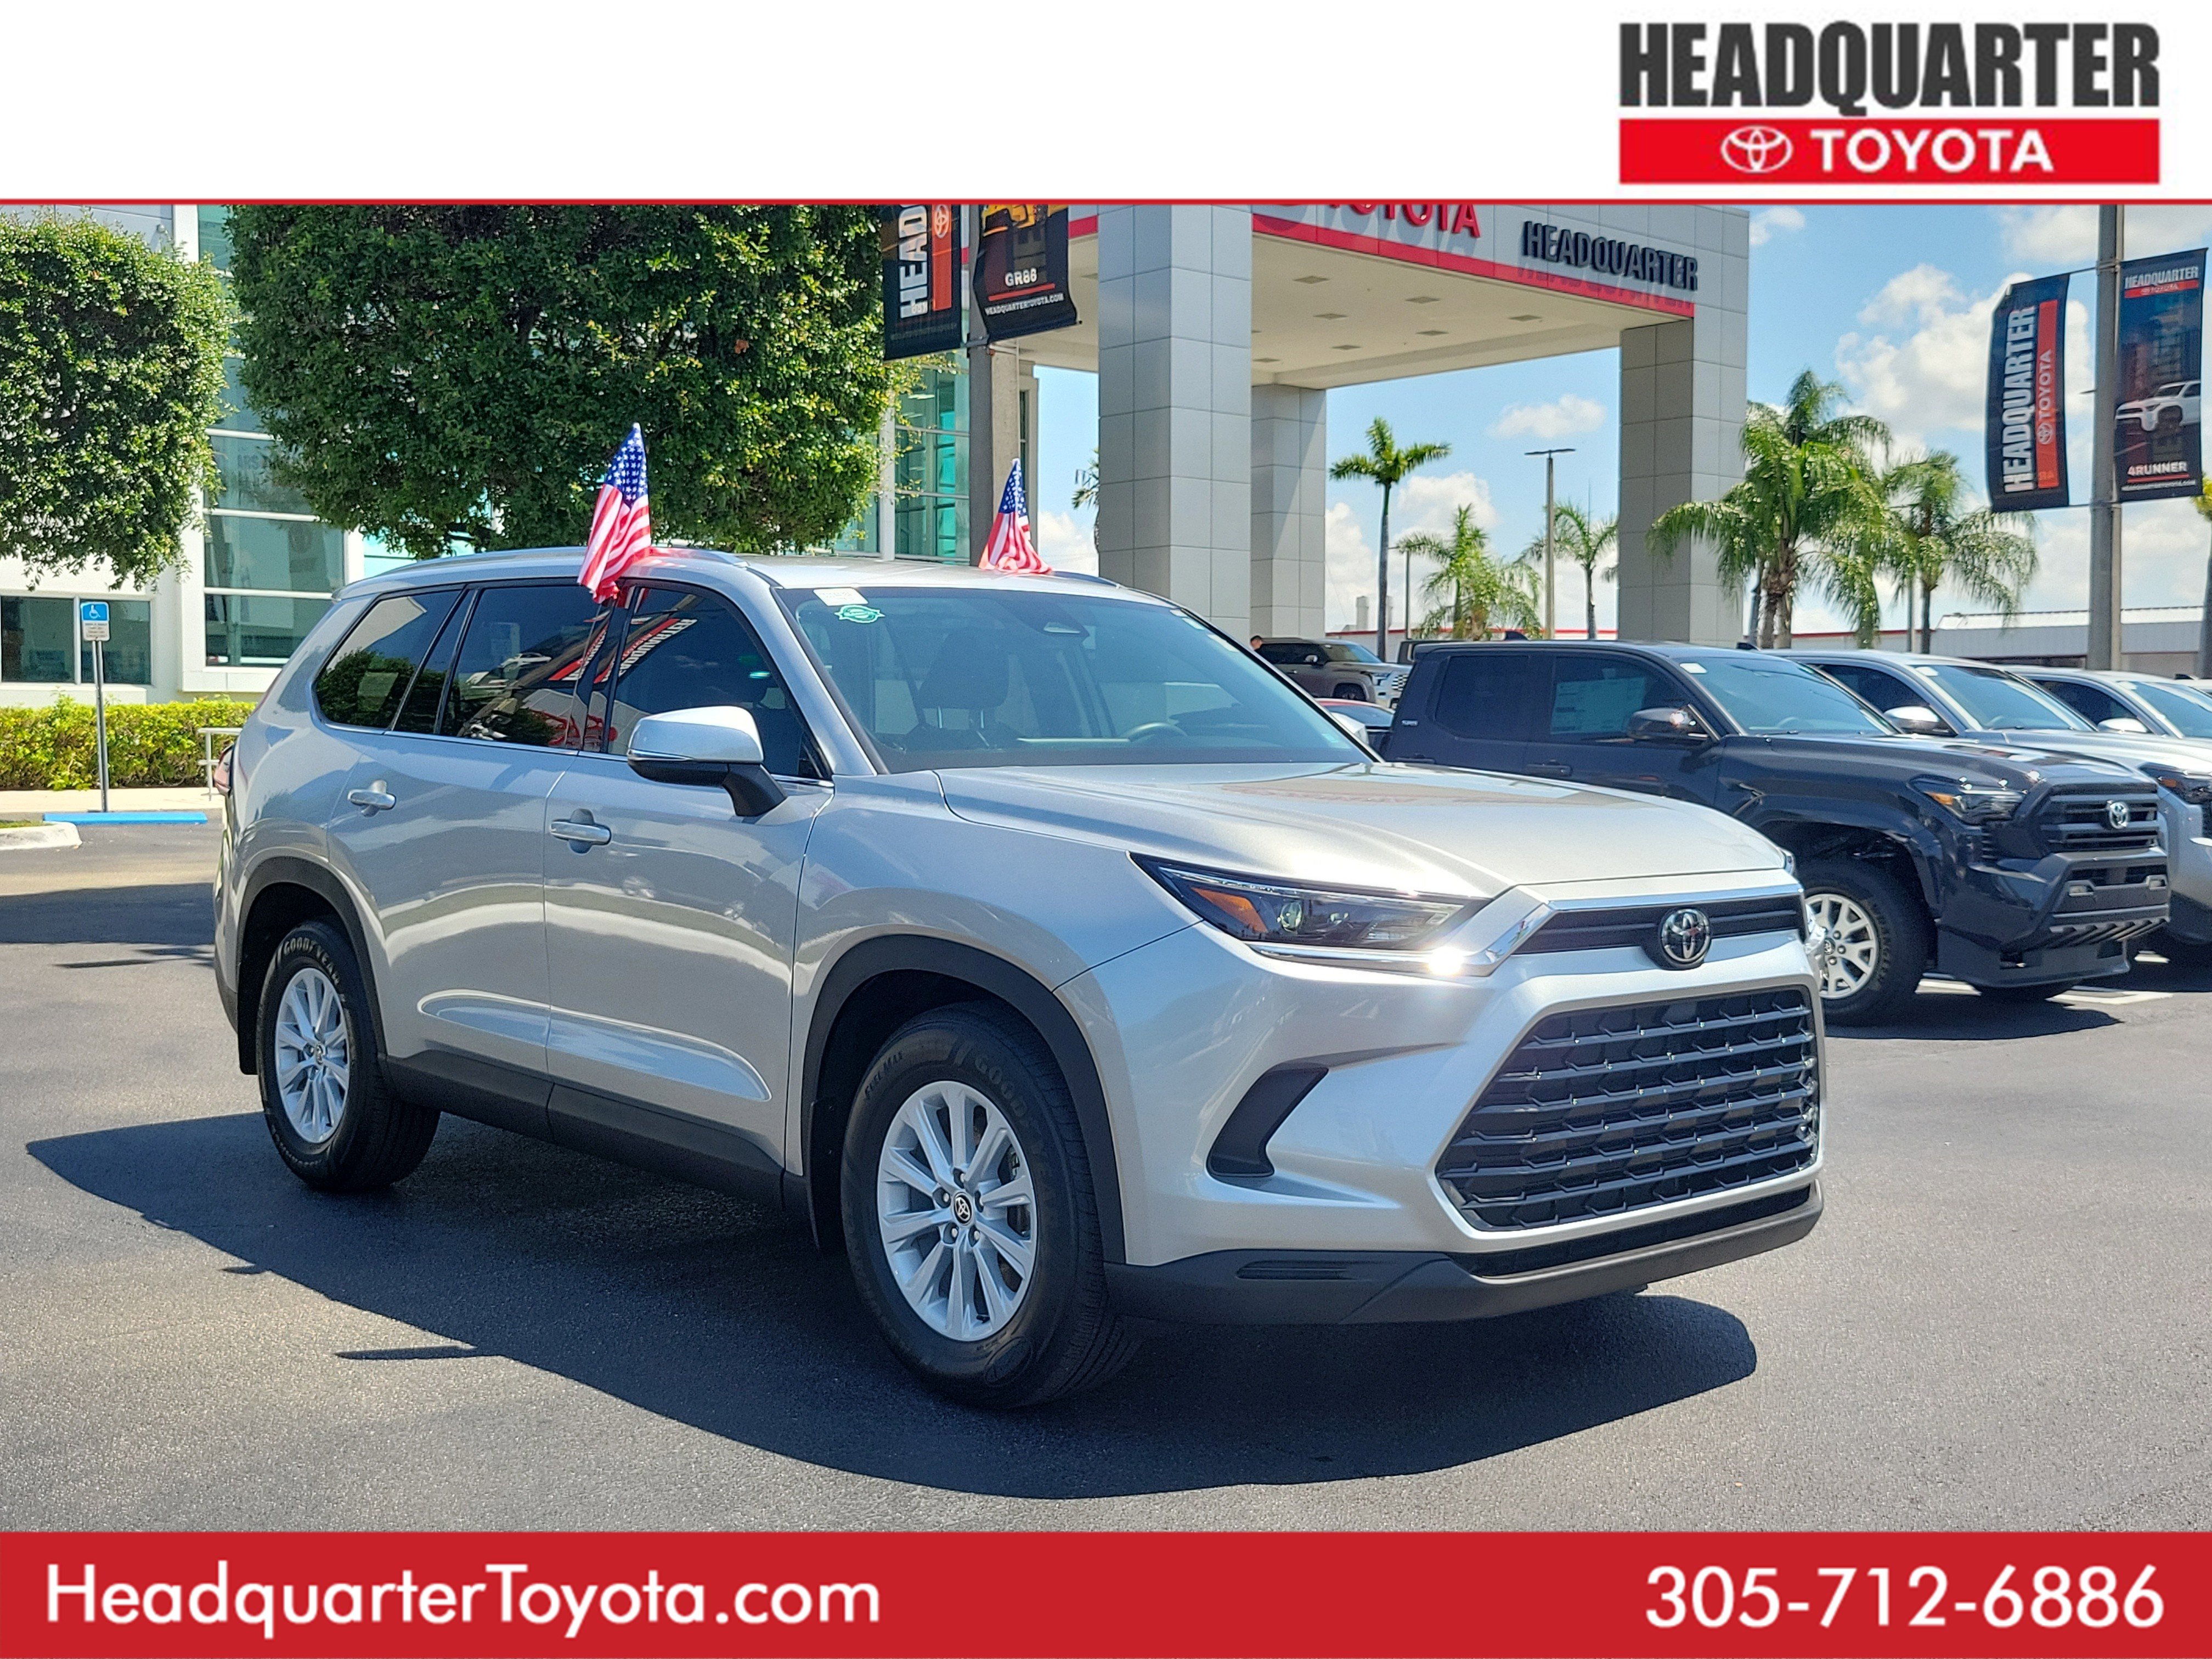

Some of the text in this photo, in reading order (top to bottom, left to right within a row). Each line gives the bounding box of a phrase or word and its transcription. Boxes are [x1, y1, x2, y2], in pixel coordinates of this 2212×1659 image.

[899, 205, 928, 318] HEAD
[1005, 268, 1037, 287] GR86
[1523, 221, 1699, 291] HEADQUARTER
[2124, 266, 2199, 290] HEADQUARTER
[2002, 306, 2036, 493] HEADQUARTER
[2039, 349, 2052, 420] TOYOTA
[2128, 461, 2187, 477] 4RUNNER
